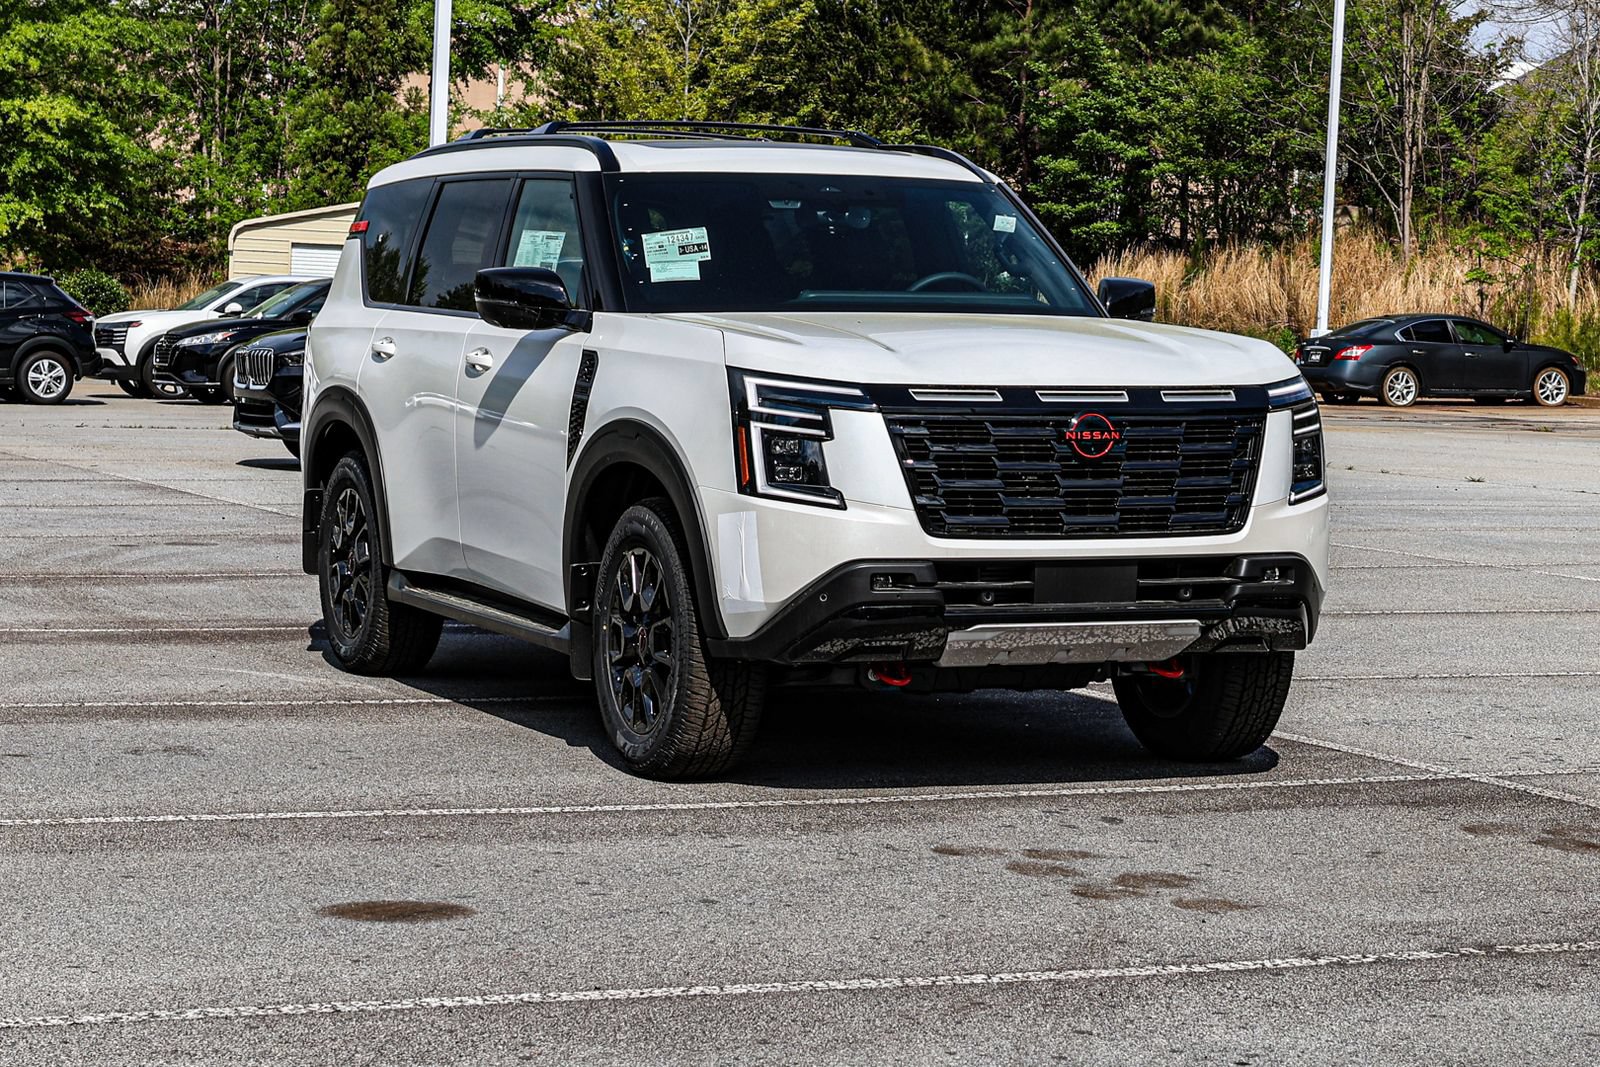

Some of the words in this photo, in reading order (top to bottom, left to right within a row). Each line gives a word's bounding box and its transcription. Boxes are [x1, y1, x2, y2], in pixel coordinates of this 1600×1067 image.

[666, 232, 694, 244] 124347
[684, 245, 699, 253] USA
[1065, 431, 1120, 440] NISSAN
